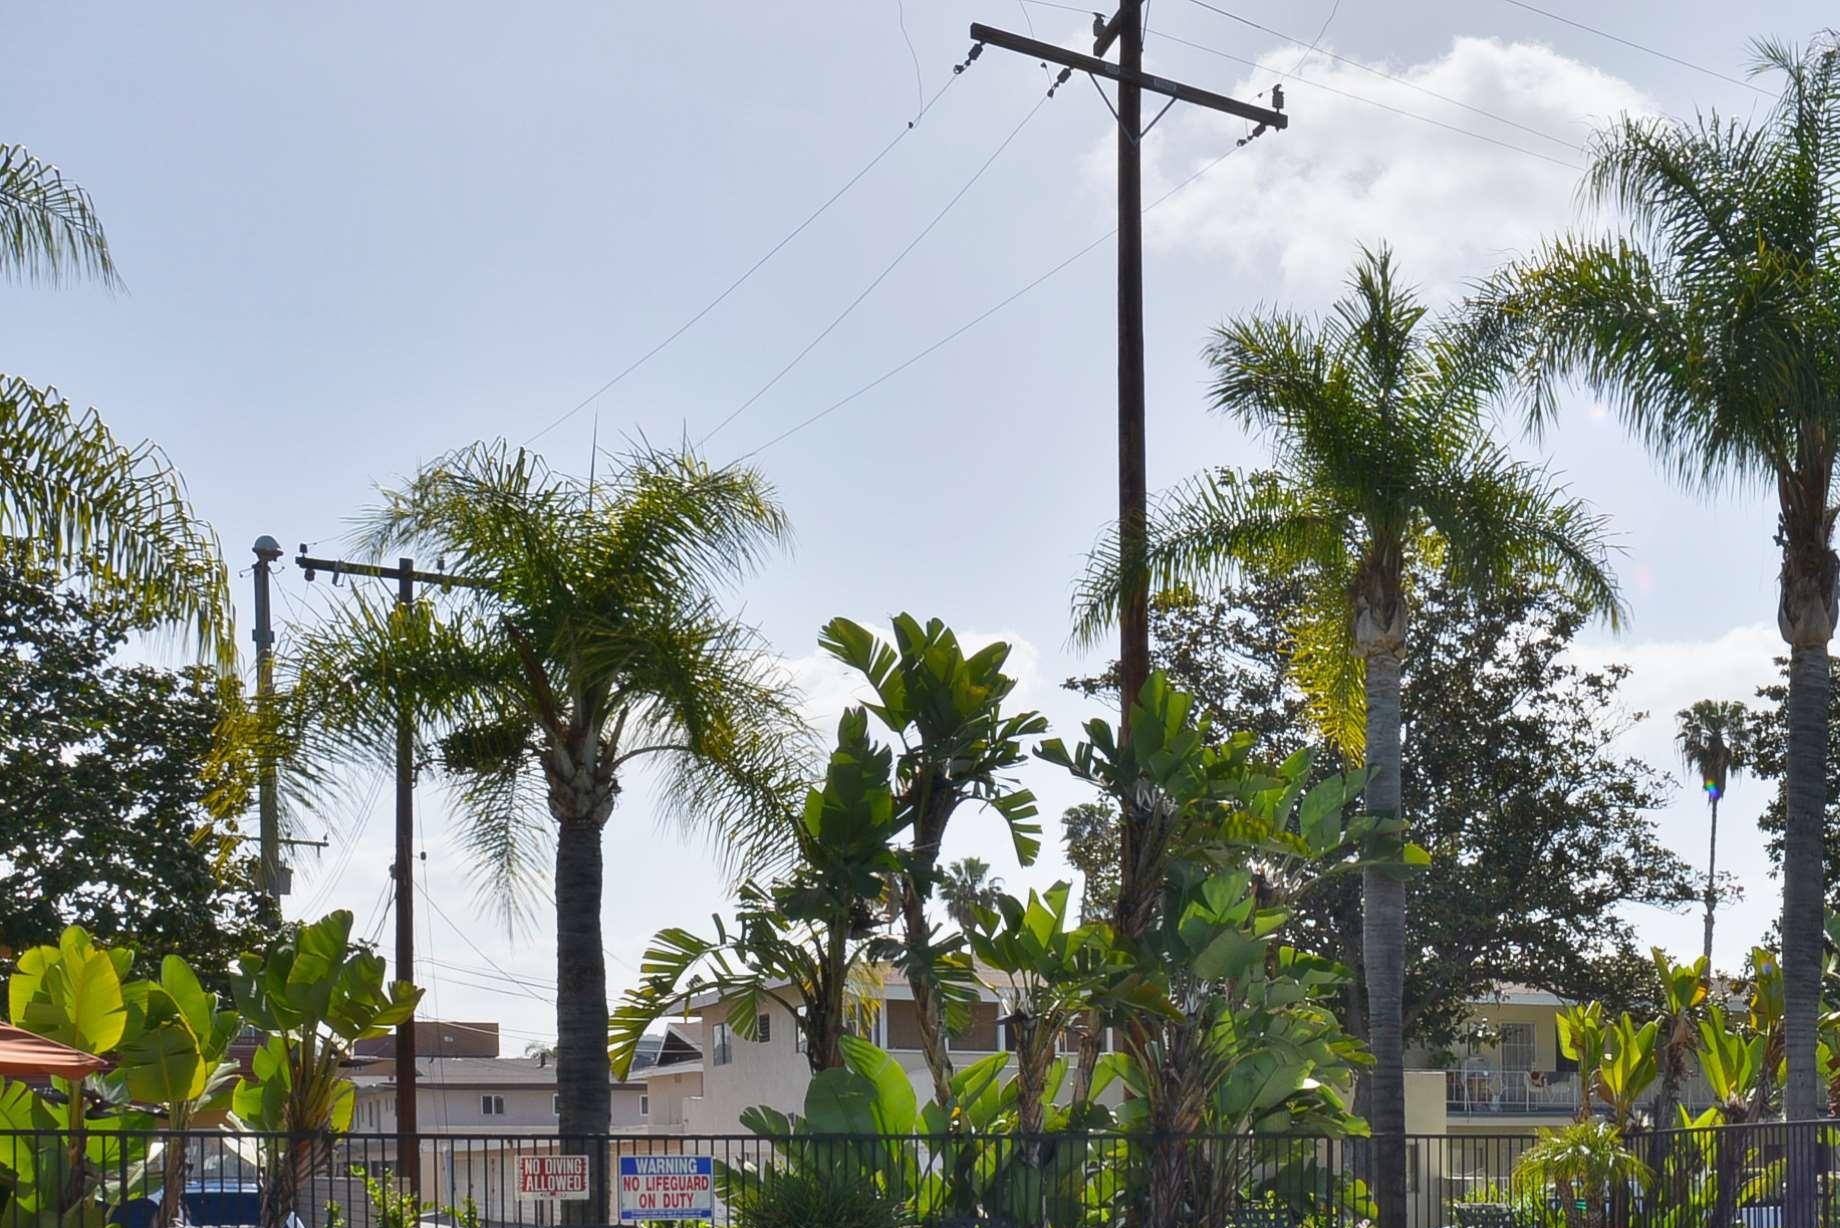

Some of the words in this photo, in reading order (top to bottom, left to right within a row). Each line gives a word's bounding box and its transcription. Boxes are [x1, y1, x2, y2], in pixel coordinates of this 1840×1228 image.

[525, 1158, 540, 1175] NO
[545, 1158, 582, 1175] DIVING
[635, 1158, 698, 1174] WARNING
[526, 1175, 582, 1191] ALLOWED
[623, 1176, 640, 1191] NO
[646, 1176, 709, 1191] LIFEGUARD
[639, 1193, 656, 1208] ON
[663, 1193, 694, 1208] DUTY
